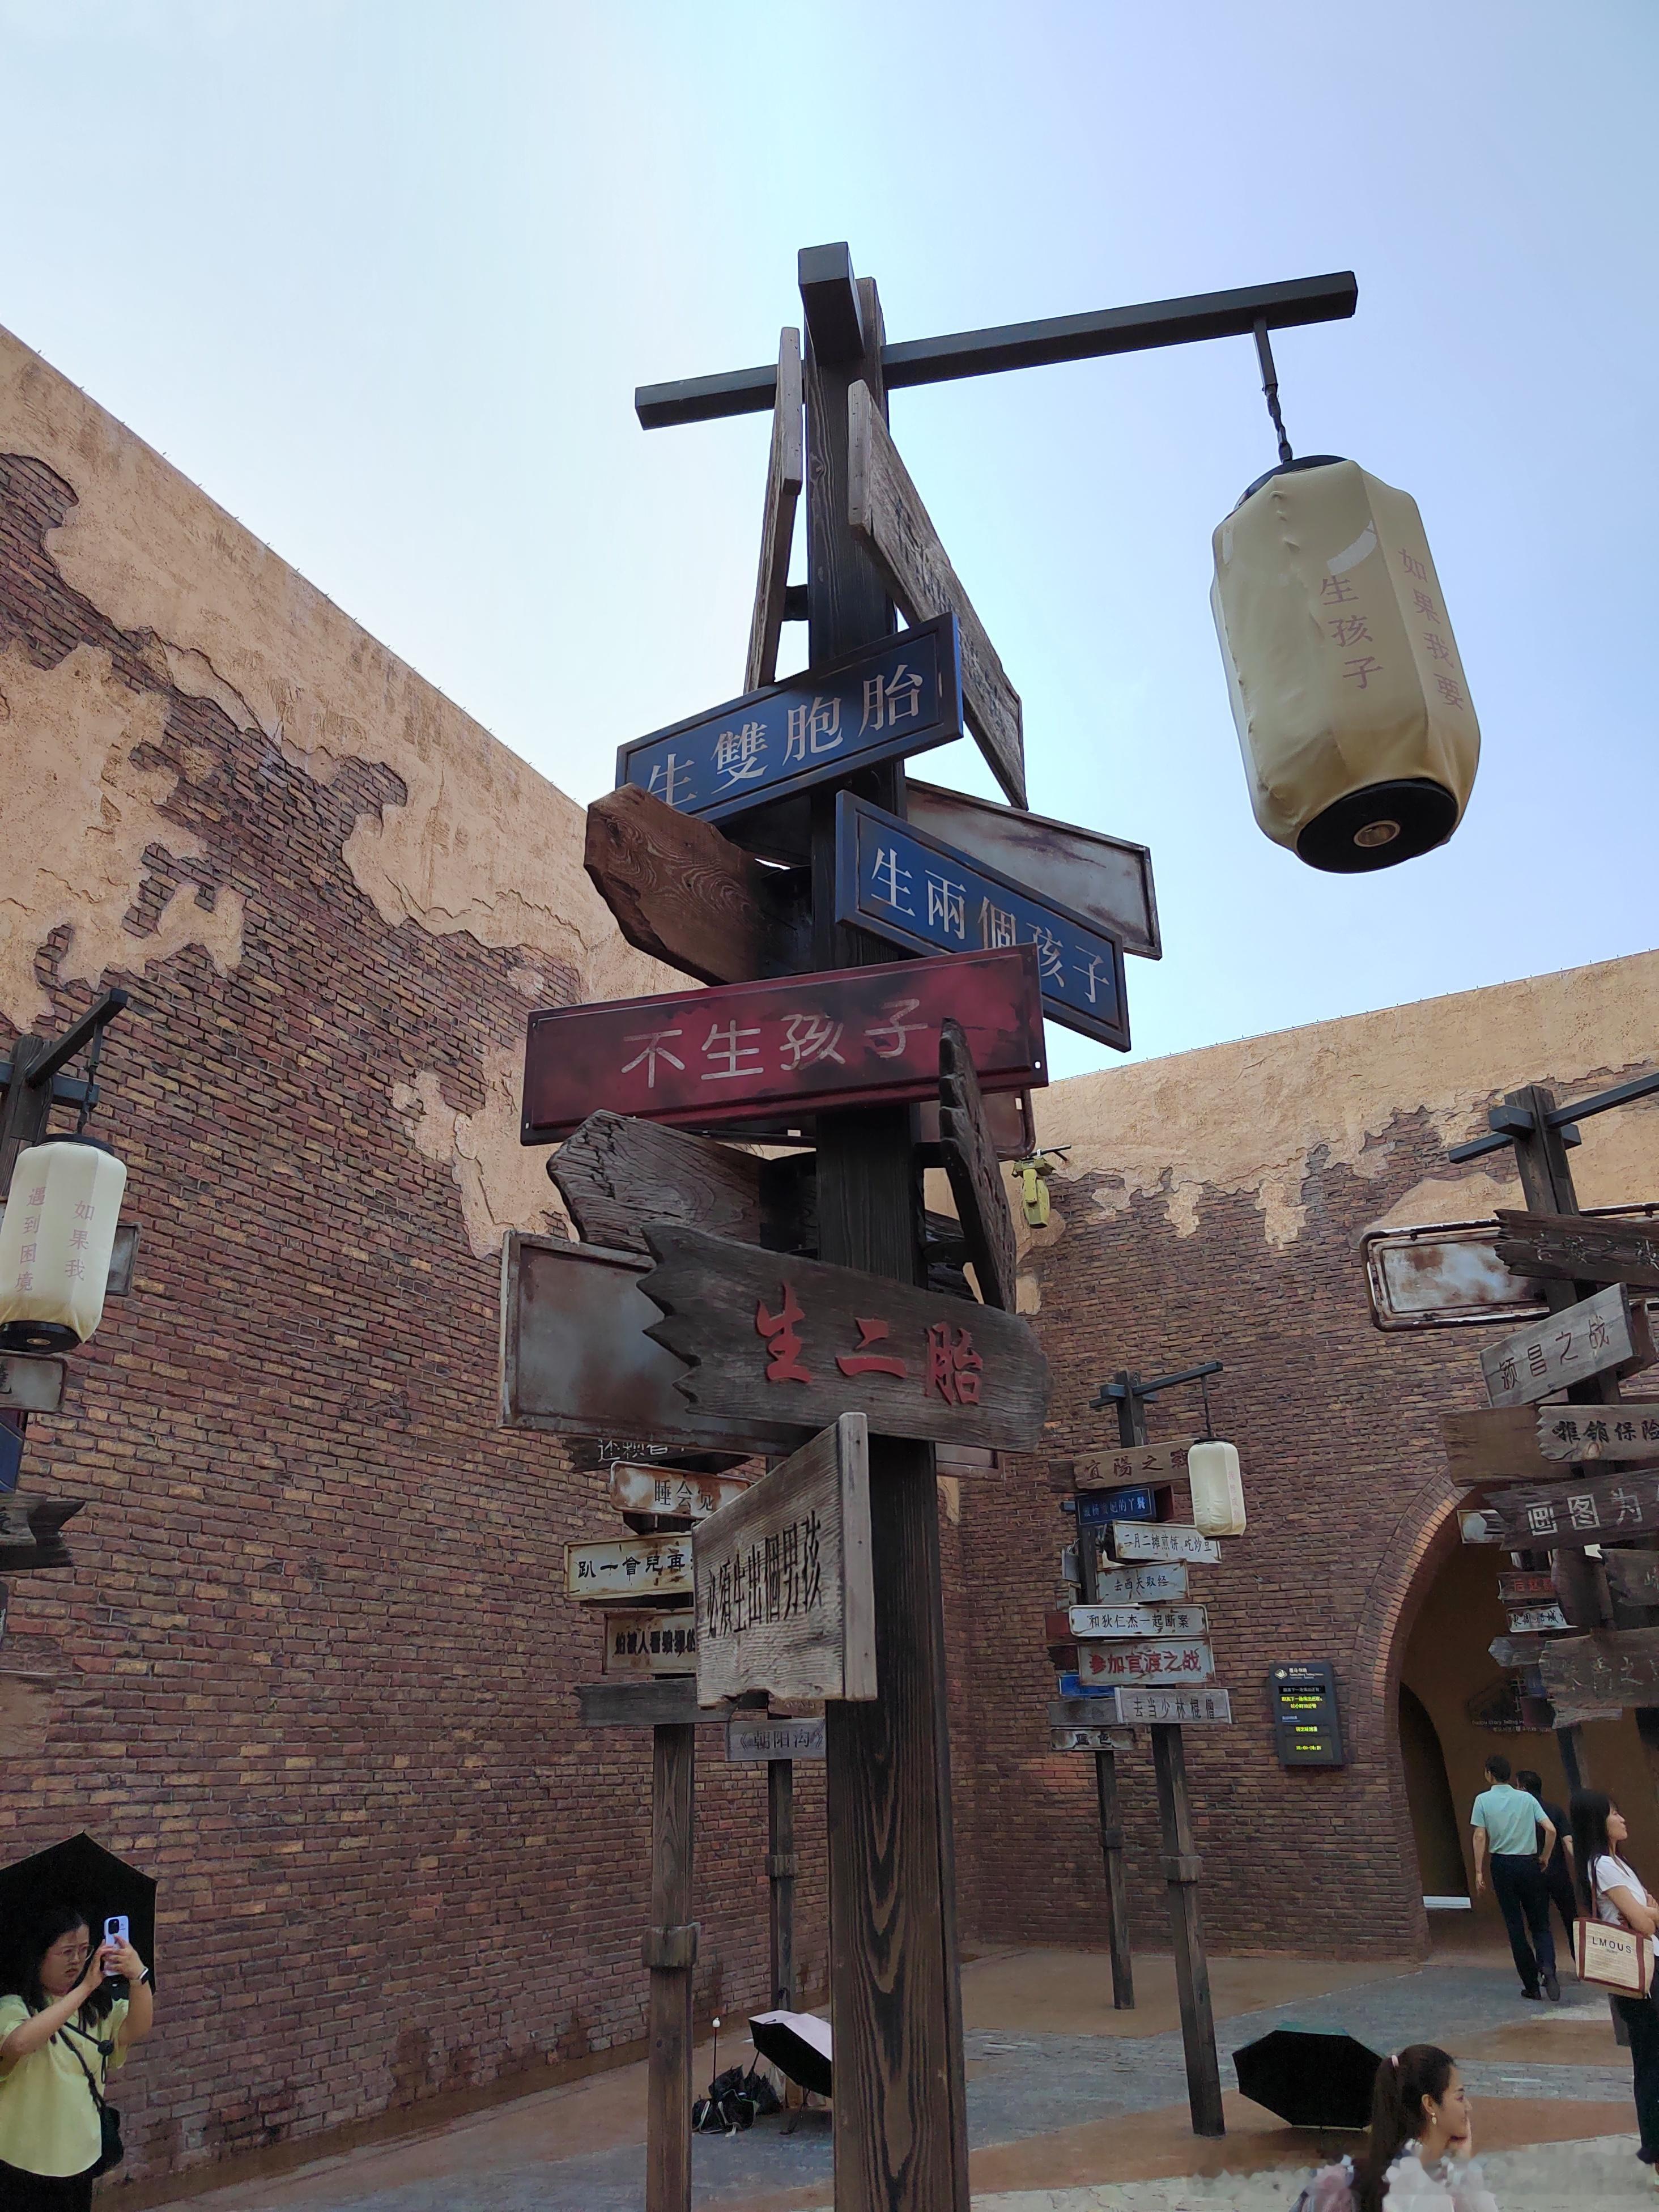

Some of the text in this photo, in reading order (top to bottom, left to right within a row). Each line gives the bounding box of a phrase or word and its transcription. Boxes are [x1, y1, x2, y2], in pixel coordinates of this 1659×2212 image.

[1320, 575, 1383, 690] 生孩子
[1398, 547, 1464, 711] 如果我要
[646, 664, 924, 807] 生雙胞胎
[870, 848, 1110, 1003] 生兩個孩子
[621, 998, 928, 1088] 不生孩子
[64, 1199, 95, 1282] 如果我
[755, 1282, 983, 1405] 生二胎
[1525, 1487, 1659, 1536] 画图为
[577, 1552, 693, 1579] 趴一會兒再
[1114, 1575, 1169, 1591] 去西天取经
[1088, 1614, 1189, 1628] 和狄仁杰一起断案
[1088, 1648, 1201, 1674] 参加官渡之战
[1133, 1695, 1215, 1720] 去当少林棍僧
[740, 1729, 823, 1751] 《朝阳沟》
[1592, 1937, 1632, 1954] LMOUS
